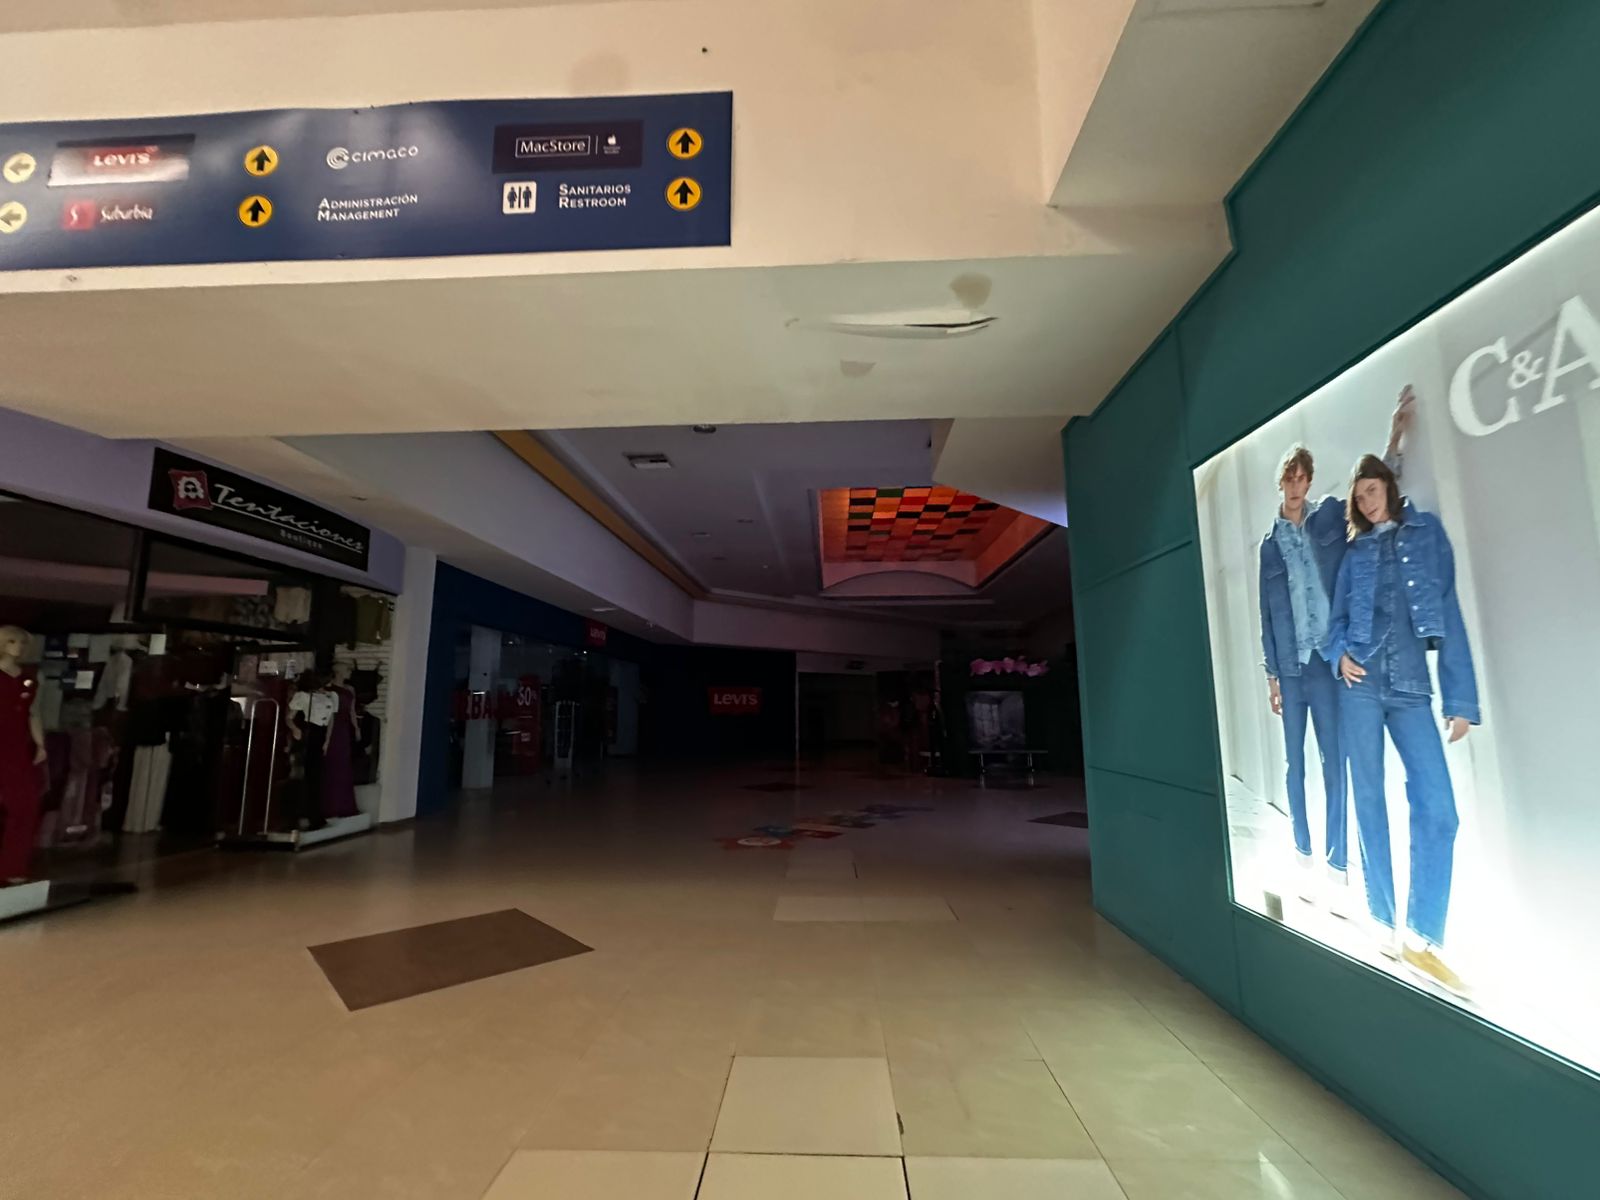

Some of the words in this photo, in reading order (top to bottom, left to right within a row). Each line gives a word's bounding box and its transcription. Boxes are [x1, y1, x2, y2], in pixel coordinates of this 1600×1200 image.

[352, 145, 419, 163] cimaco
[520, 139, 586, 154] MacStore
[559, 183, 631, 196] SANITARIOS
[319, 193, 418, 210] ADMINISTRACIÓN
[559, 196, 626, 209] RESTROOM
[317, 208, 400, 222] MANAGEMENT
[1449, 294, 1600, 437] C&A
[213, 483, 364, 550] Tentaciones
